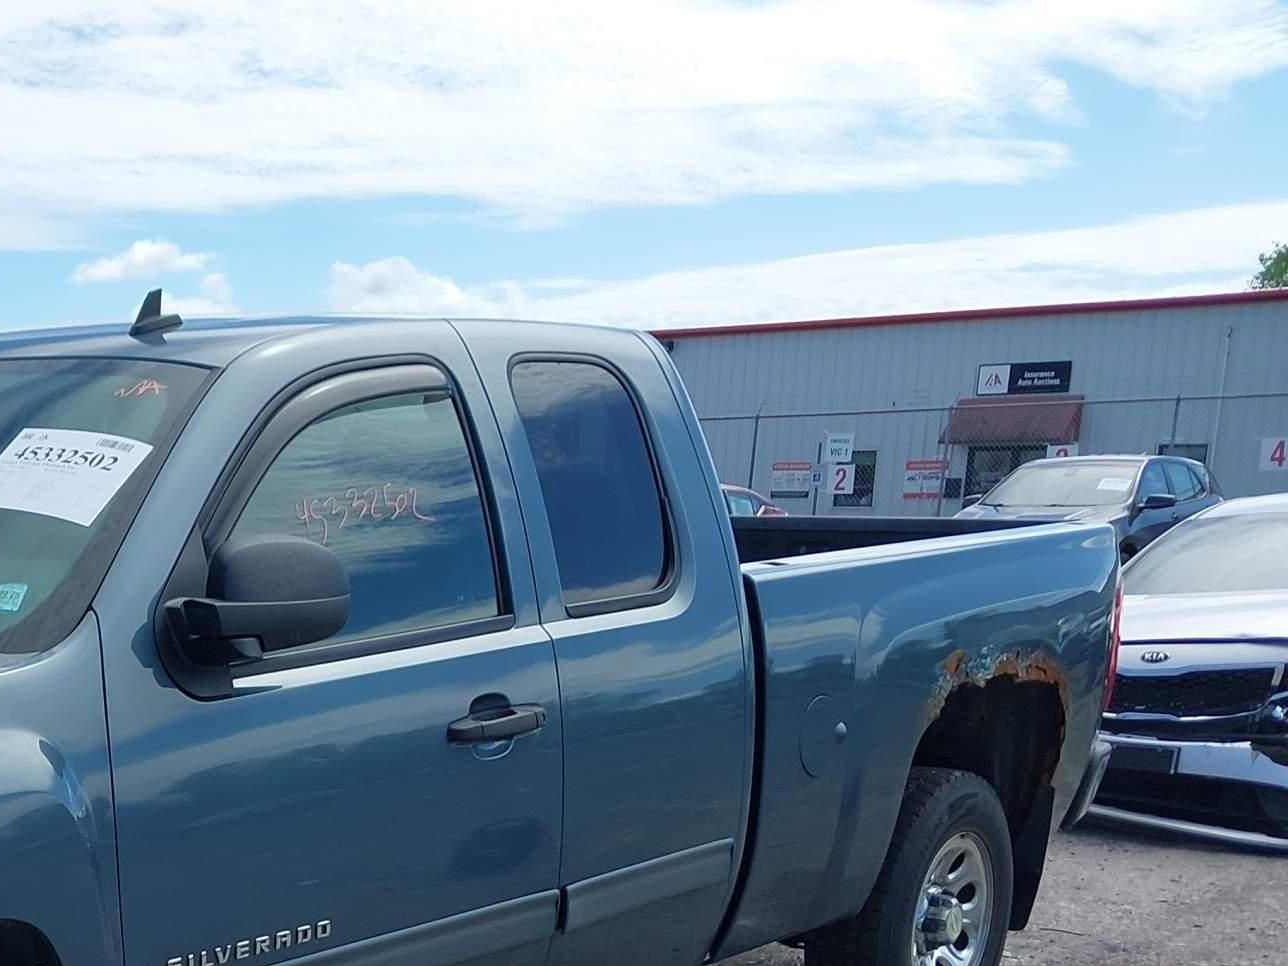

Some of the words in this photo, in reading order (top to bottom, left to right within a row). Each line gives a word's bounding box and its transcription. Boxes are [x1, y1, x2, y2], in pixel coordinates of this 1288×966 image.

[1017, 378, 1032, 386] Auto
[1033, 377, 1060, 386] Auctions
[1024, 370, 1056, 379] Insurance
[14, 444, 119, 472] 45332502
[830, 447, 842, 457] VIC
[1270, 439, 1286, 467] 4
[834, 467, 847, 491] 2
